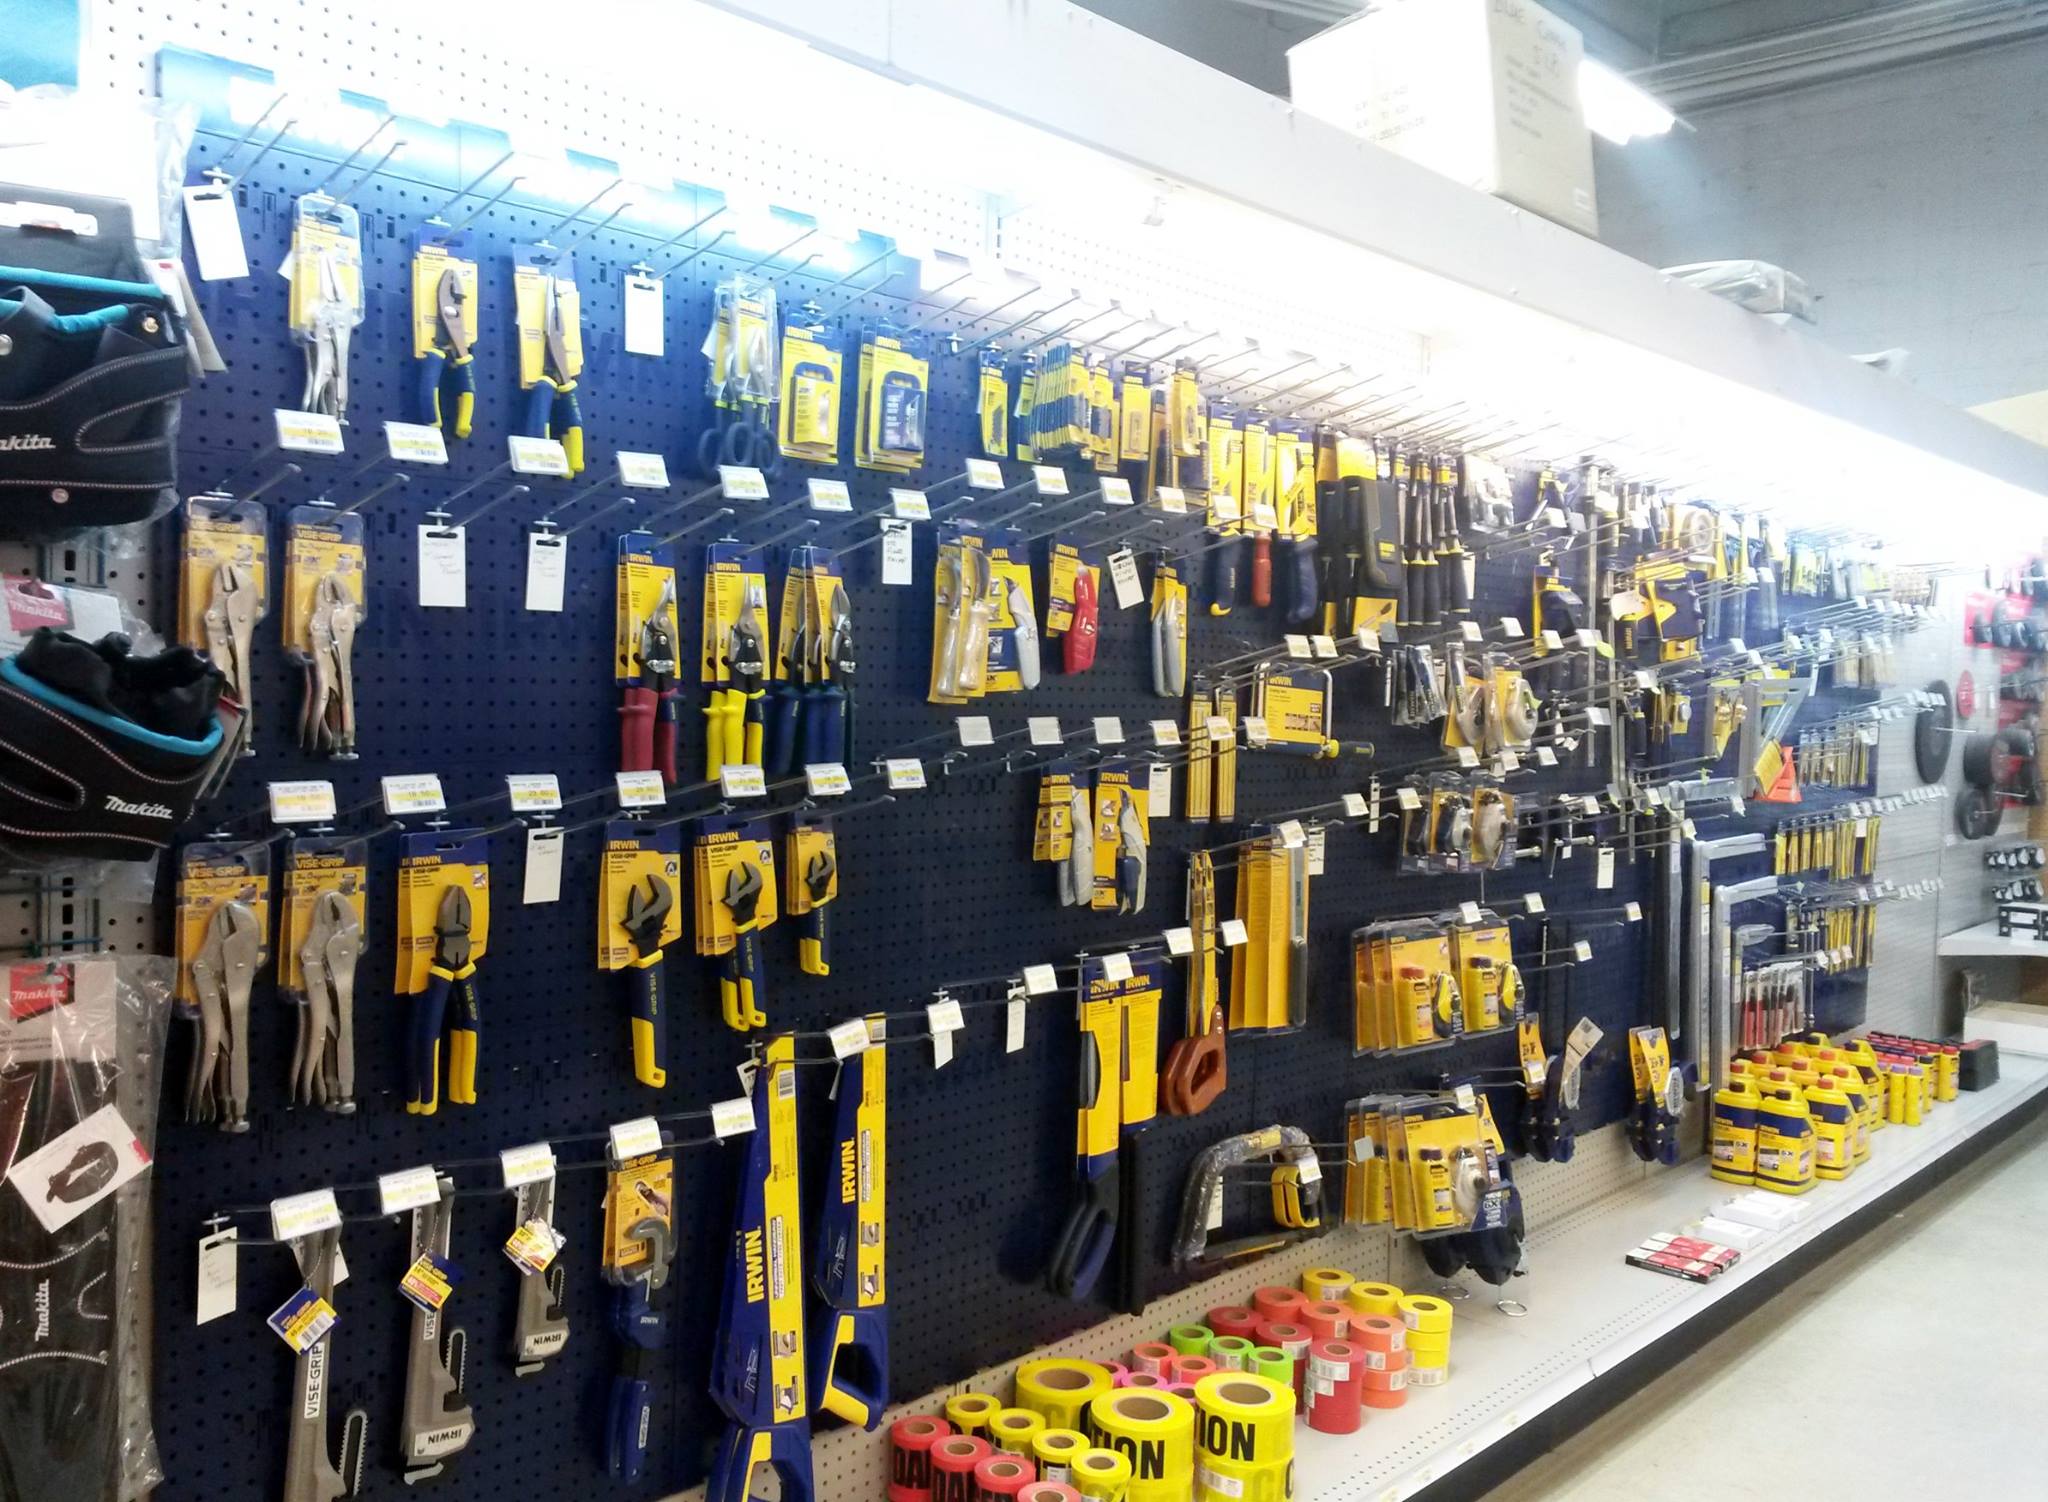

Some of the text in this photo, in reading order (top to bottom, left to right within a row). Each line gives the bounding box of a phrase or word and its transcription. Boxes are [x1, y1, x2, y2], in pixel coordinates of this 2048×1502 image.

[0, 434, 56, 451] akita
[610, 839, 640, 850] IRWIN
[708, 831, 739, 844] IRWIN
[296, 857, 346, 869] VISE-GRIP
[412, 856, 442, 866] IRWIN
[841, 1138, 857, 1204] IRWIN
[744, 1227, 765, 1303] IRWIN
[533, 1332, 562, 1346] IRWIN
[307, 1345, 323, 1418] VISE-GRIP
[427, 1428, 463, 1445] IRWIN
[1199, 1408, 1256, 1462] ION
